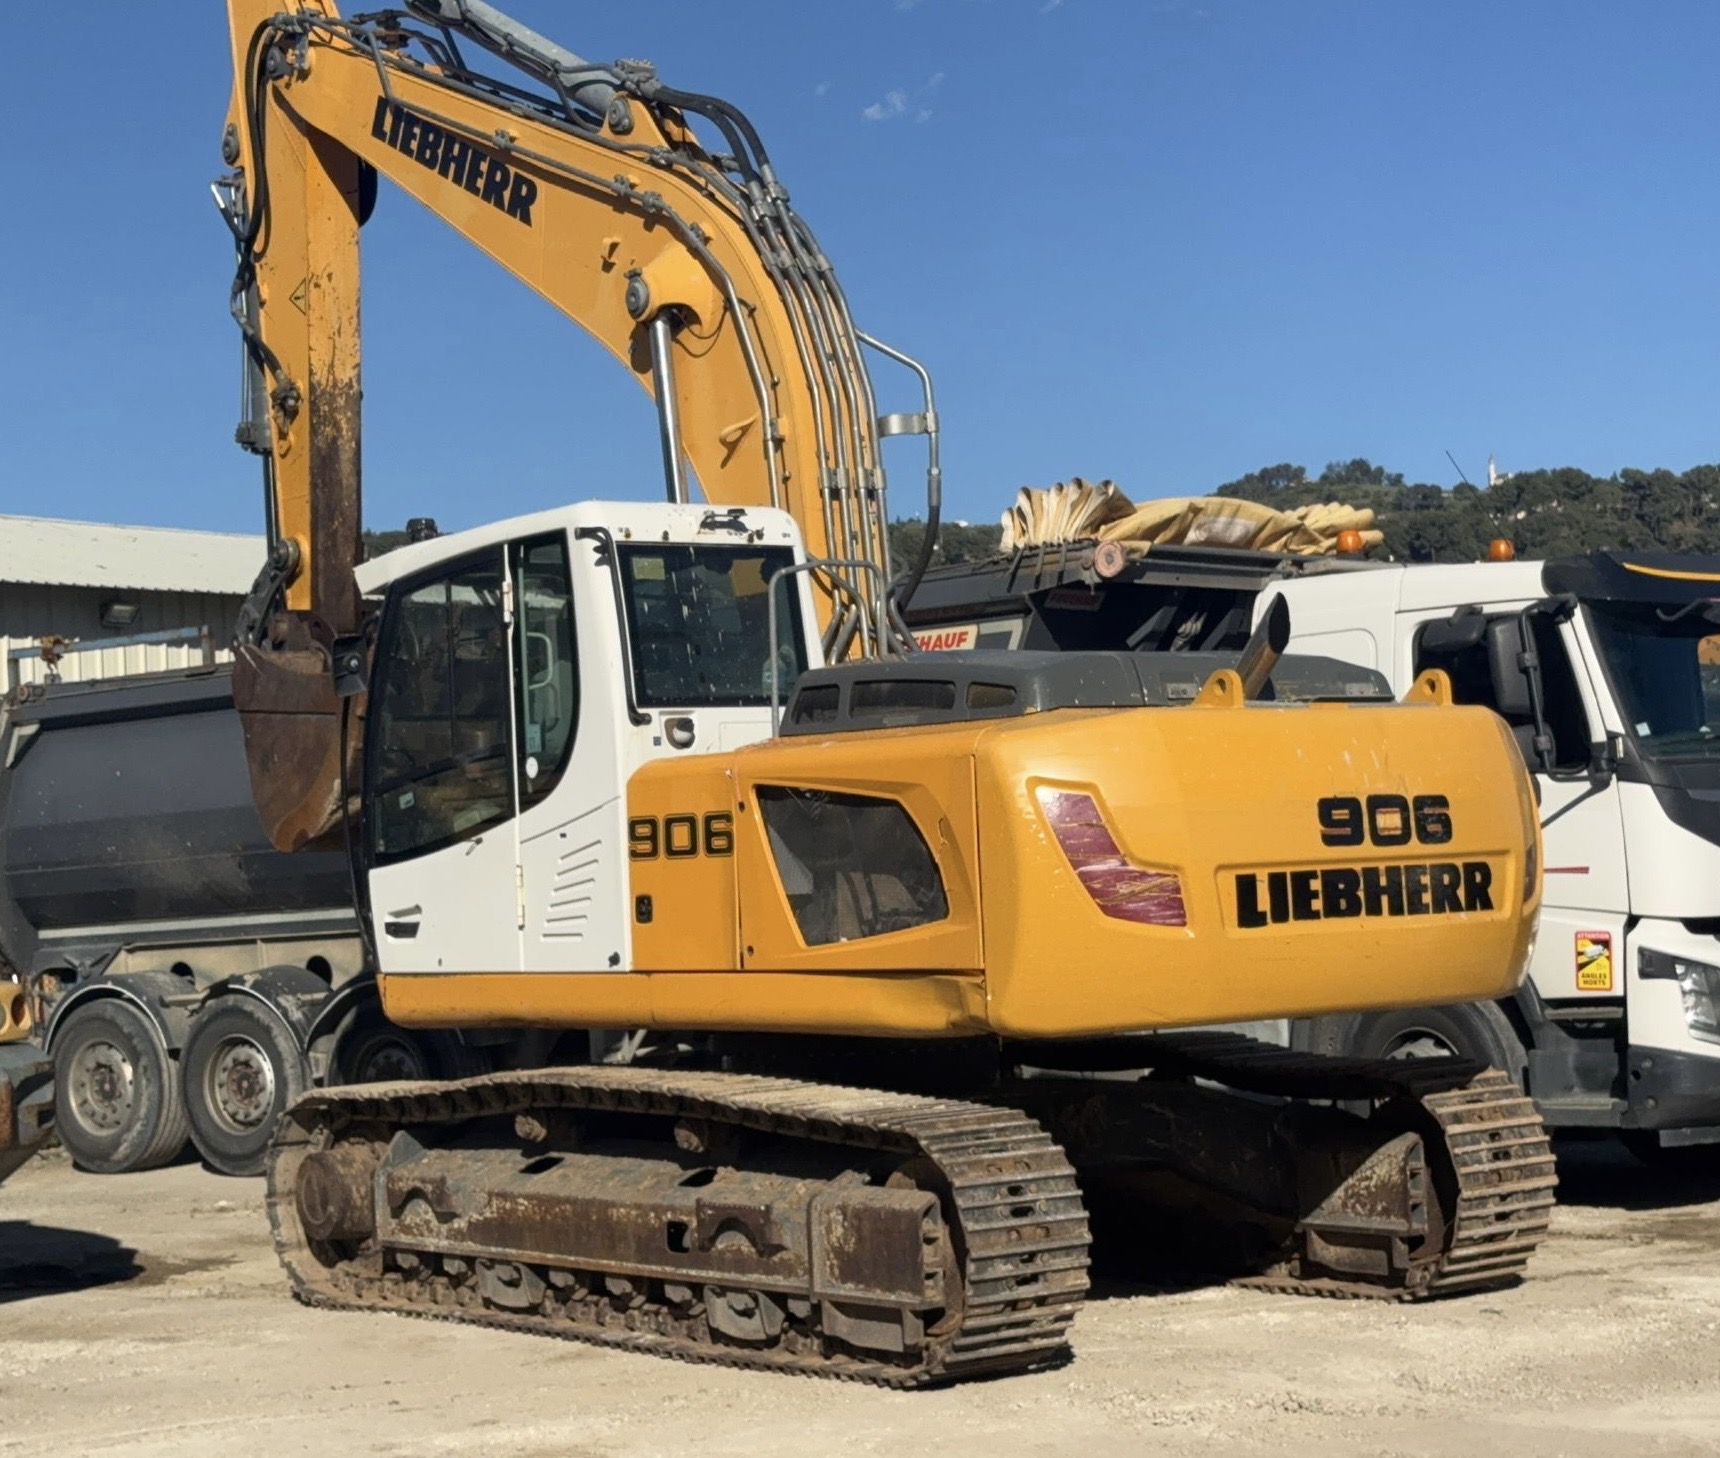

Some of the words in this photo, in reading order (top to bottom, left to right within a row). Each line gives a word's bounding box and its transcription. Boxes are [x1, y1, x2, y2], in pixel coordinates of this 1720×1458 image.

[371, 95, 538, 228] LIEBHERR
[915, 631, 969, 651] HAUF
[629, 811, 734, 860] 906
[1317, 794, 1453, 846] 906
[1235, 862, 1494, 928] LIEBHERR
